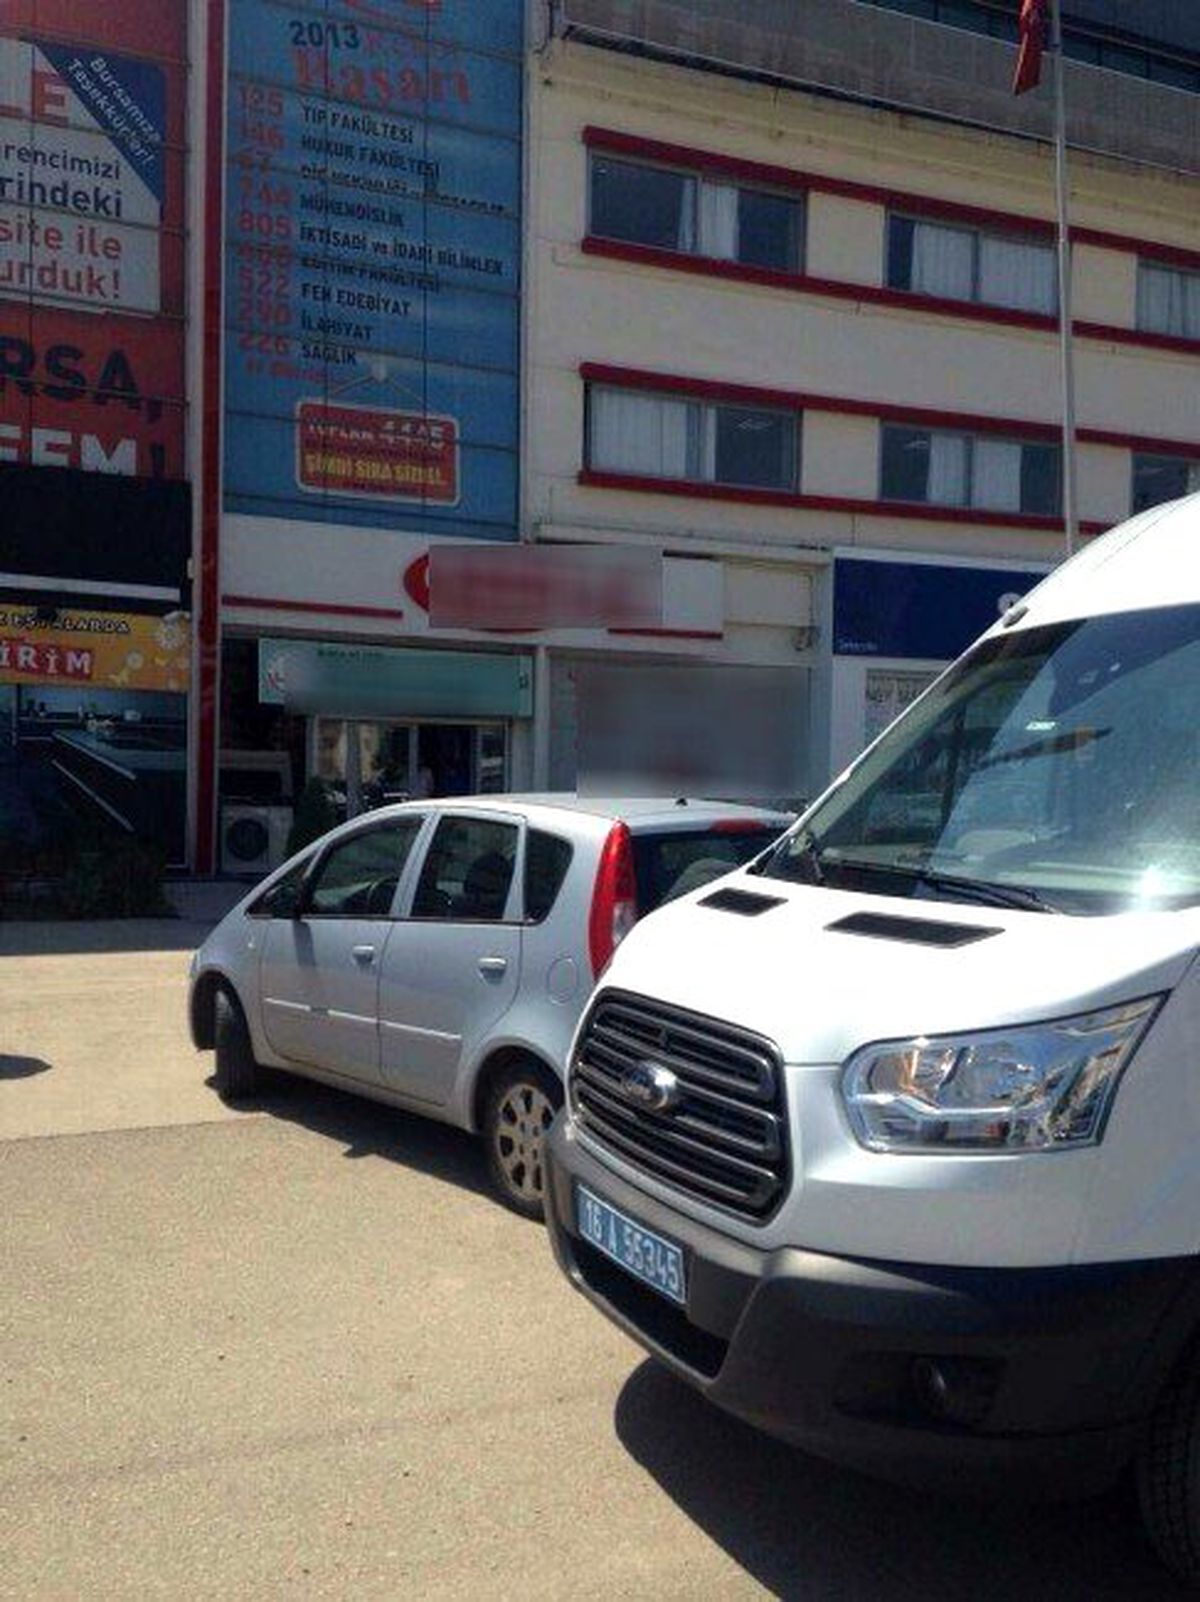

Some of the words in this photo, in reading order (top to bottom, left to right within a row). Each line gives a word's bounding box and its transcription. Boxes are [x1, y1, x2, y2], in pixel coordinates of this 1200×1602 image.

[289, 20, 361, 50] 2013
[77, 225, 122, 261] ile
[586, 1199, 602, 1241] 16
